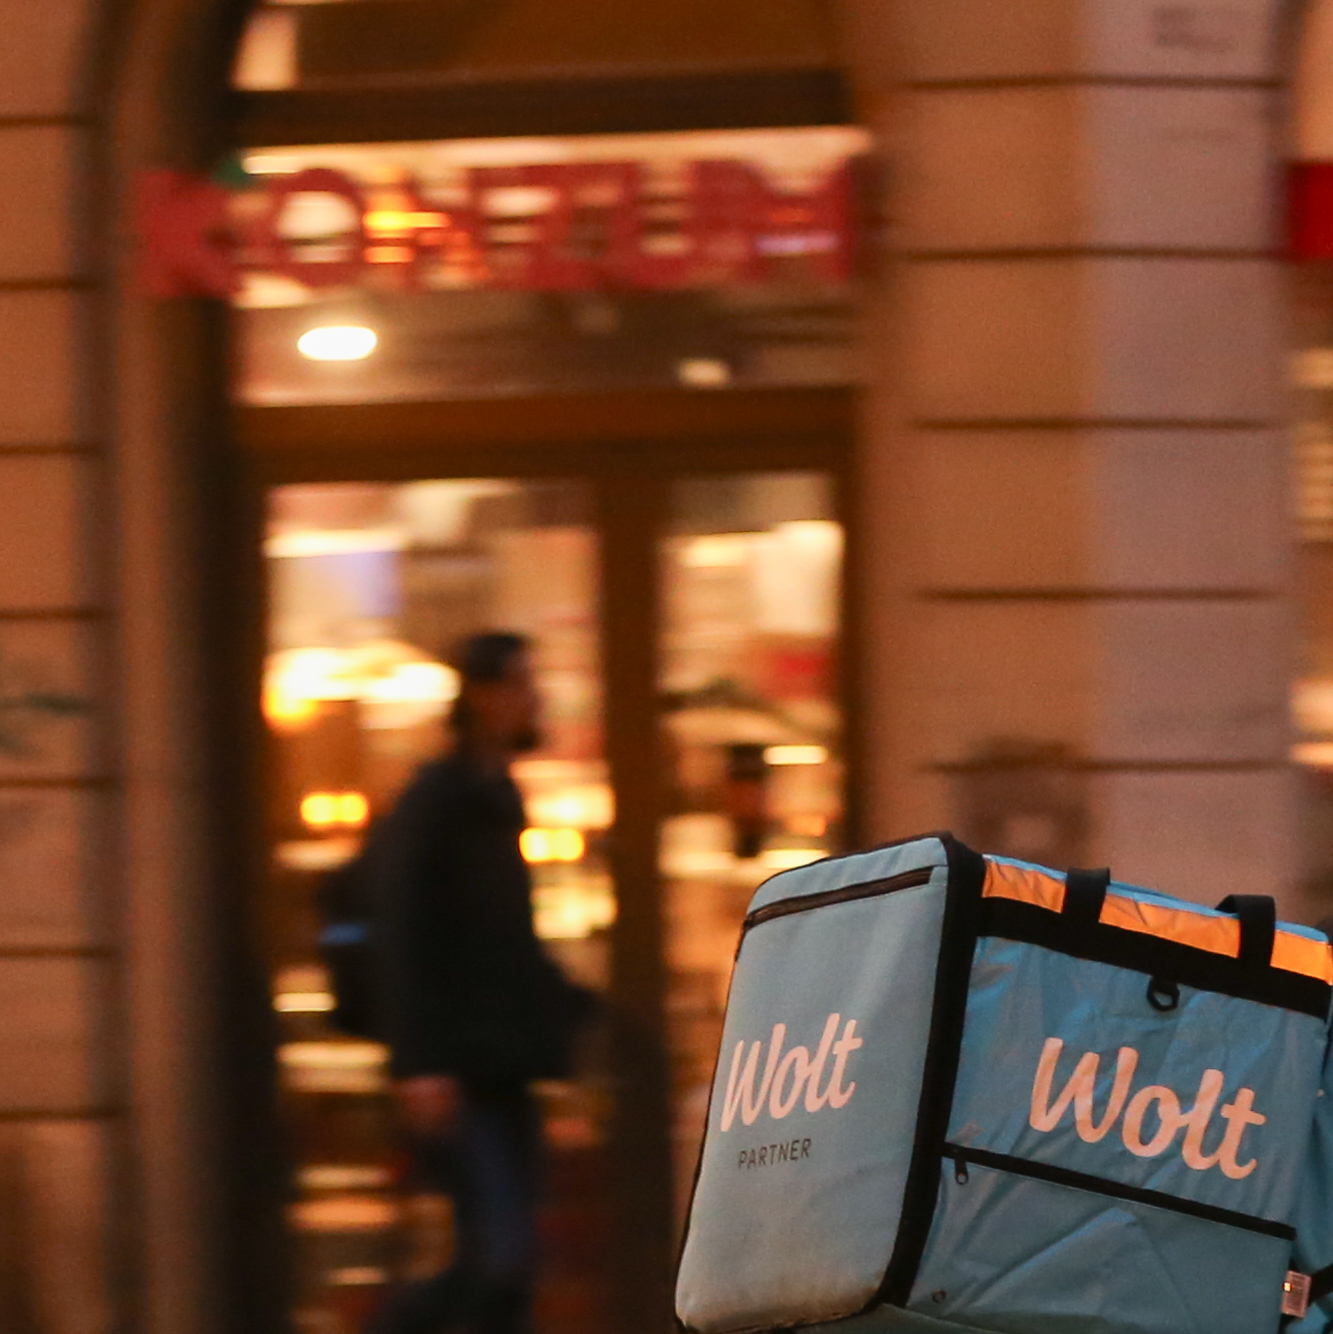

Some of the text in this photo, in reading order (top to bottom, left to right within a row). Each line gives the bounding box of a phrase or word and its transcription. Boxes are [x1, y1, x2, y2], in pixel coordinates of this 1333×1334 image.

[719, 1012, 863, 1132] Wolt
[1029, 1036, 1267, 1181] Wolt
[738, 1138, 812, 1170] PARTNER
